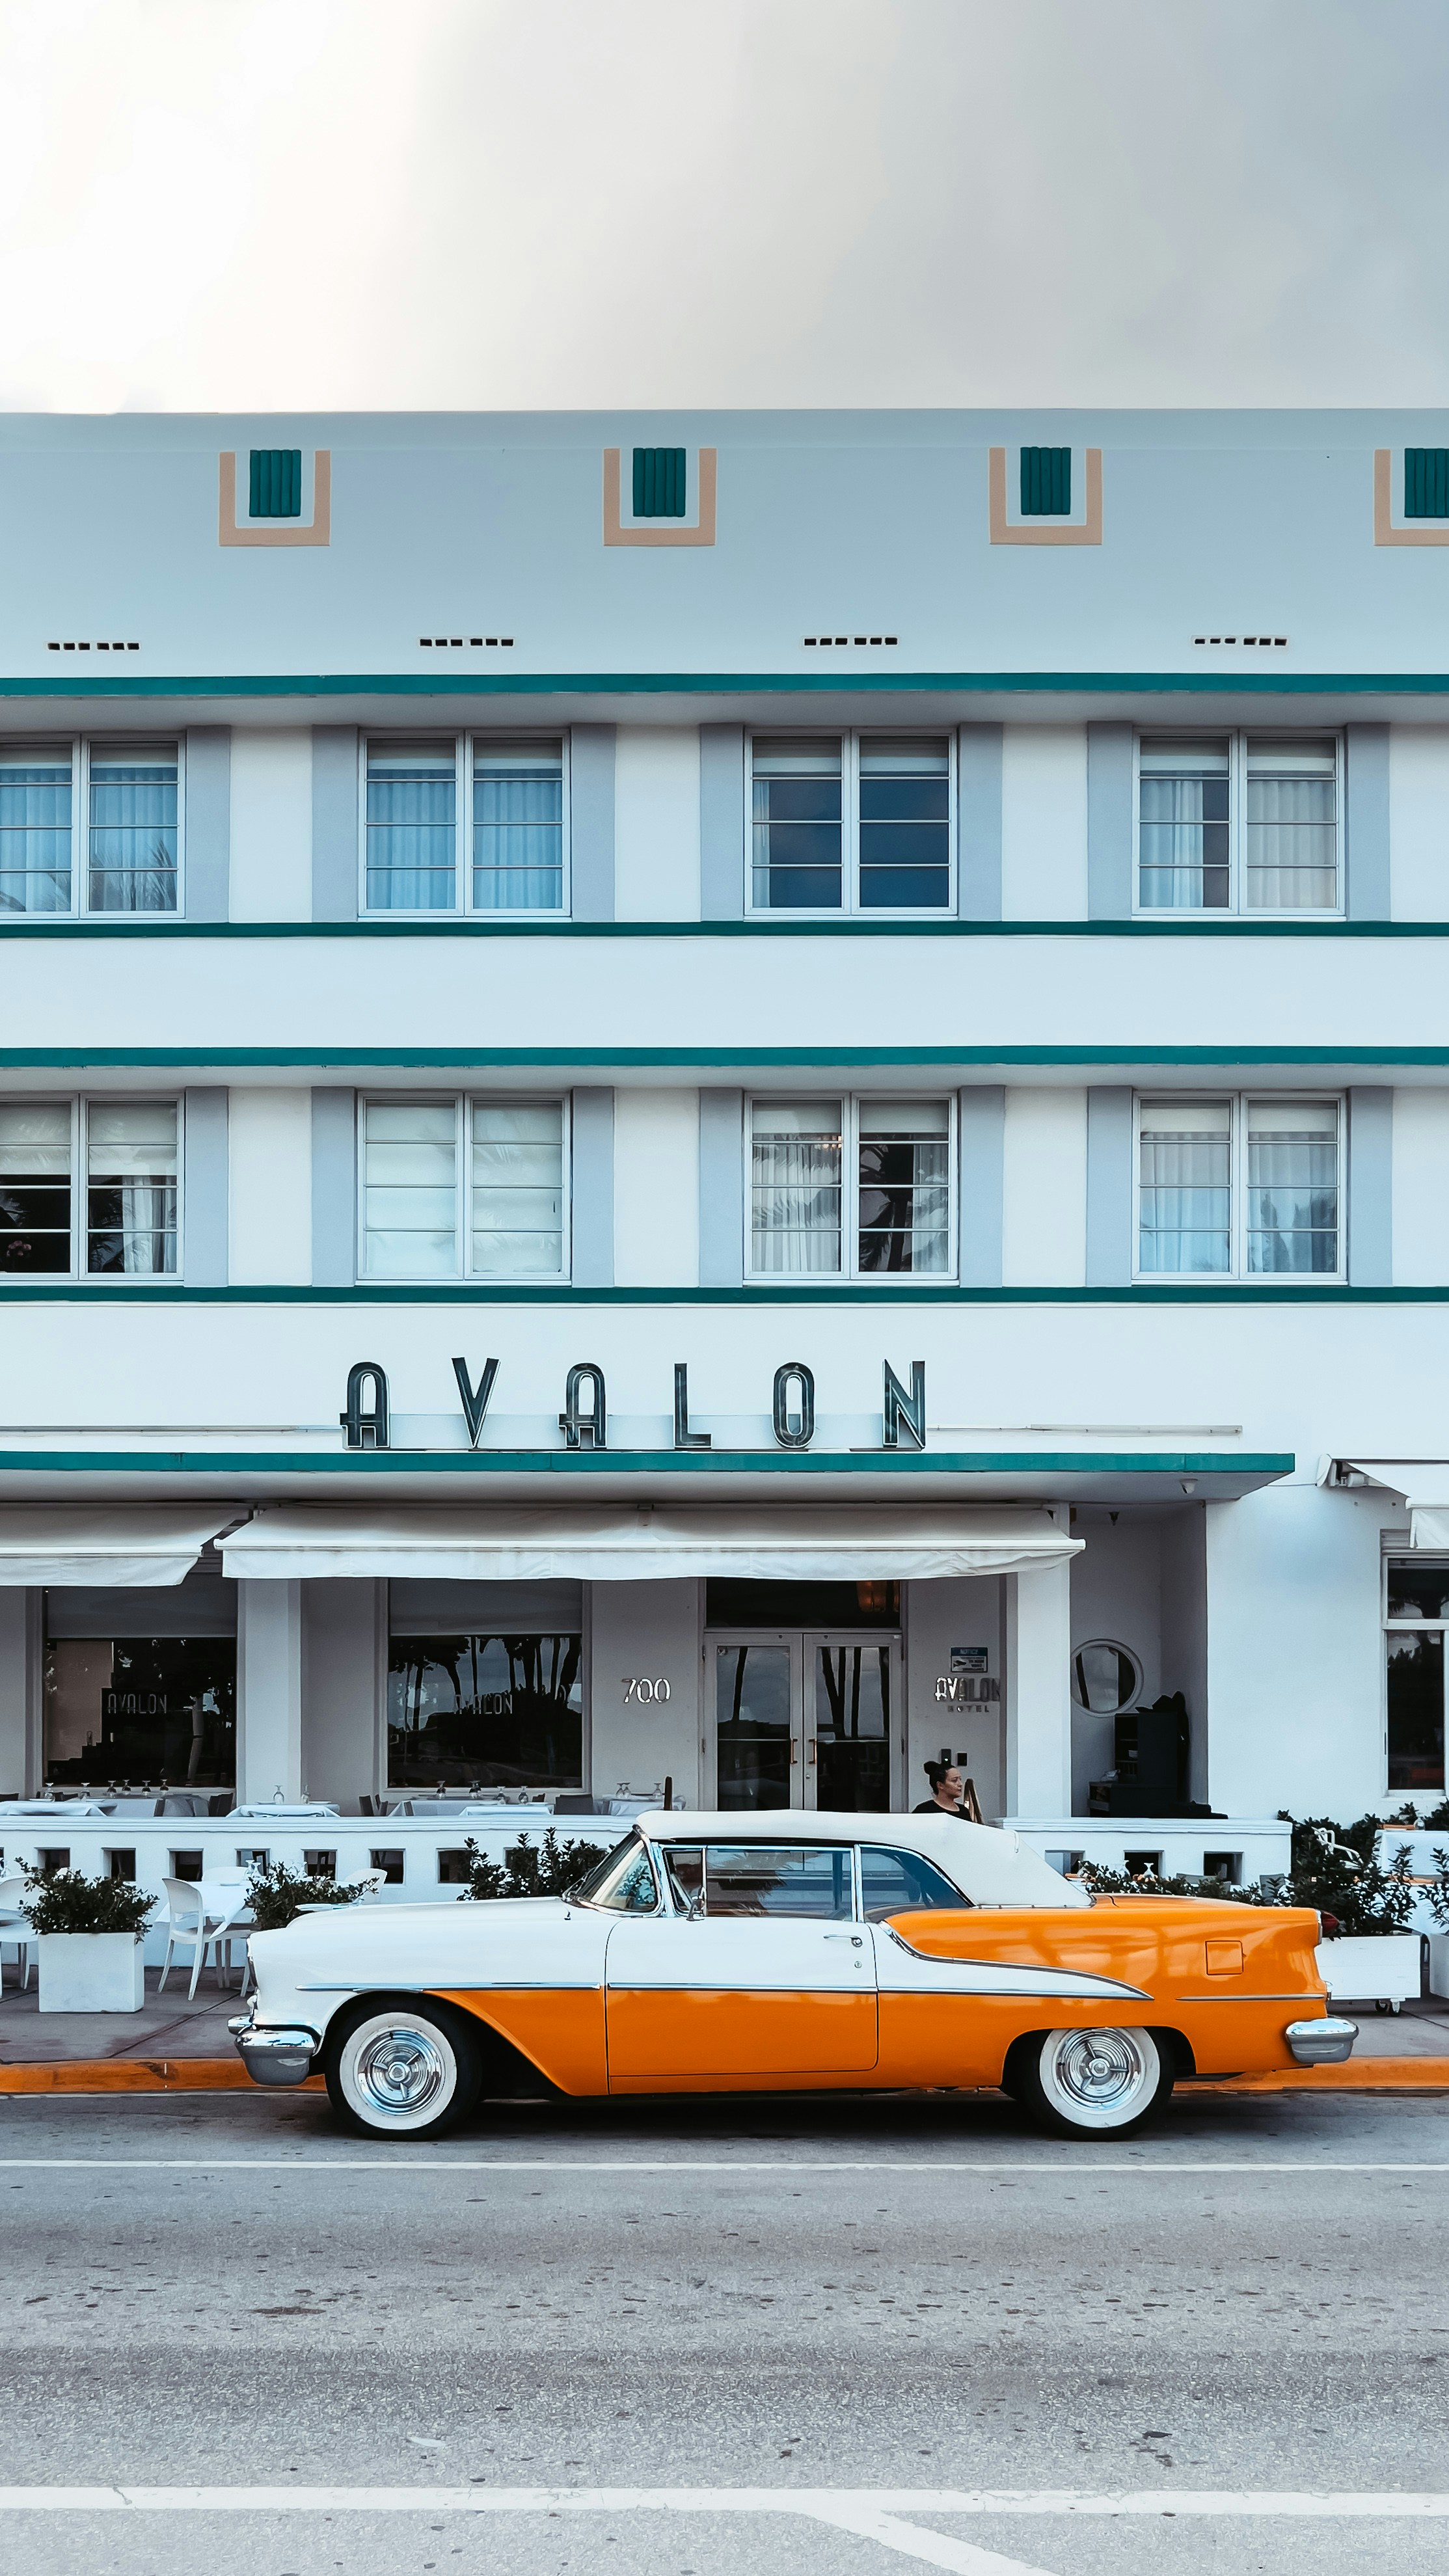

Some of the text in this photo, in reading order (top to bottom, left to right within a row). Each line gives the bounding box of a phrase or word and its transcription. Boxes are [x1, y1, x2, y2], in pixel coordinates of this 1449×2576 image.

[339, 1357, 927, 1450] AVALON
[621, 1678, 671, 1703] 700
[934, 1677, 1001, 1702] AVALON
[107, 1694, 167, 1715] AVALON
[454, 1694, 513, 1715] AVALON
